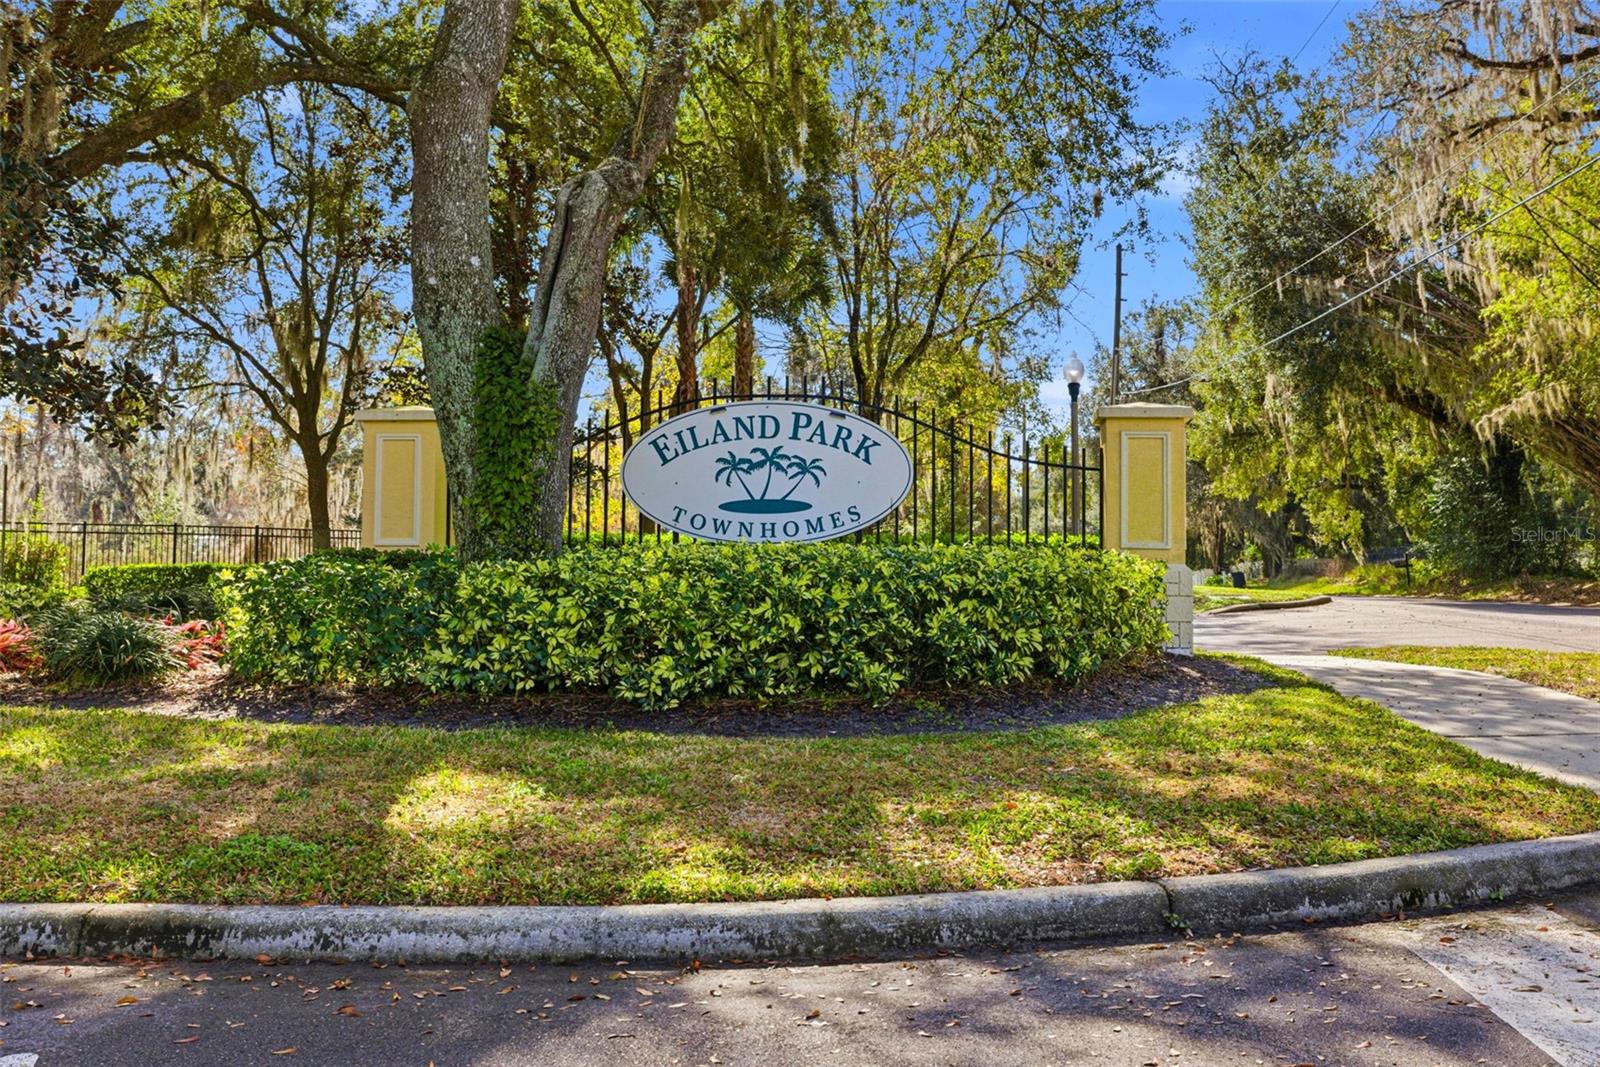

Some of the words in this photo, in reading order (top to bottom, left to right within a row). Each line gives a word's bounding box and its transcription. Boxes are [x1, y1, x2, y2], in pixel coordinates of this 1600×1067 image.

[648, 415, 780, 467] EILAND
[788, 411, 881, 465] PARK
[672, 505, 862, 538] TOWNHOMES
